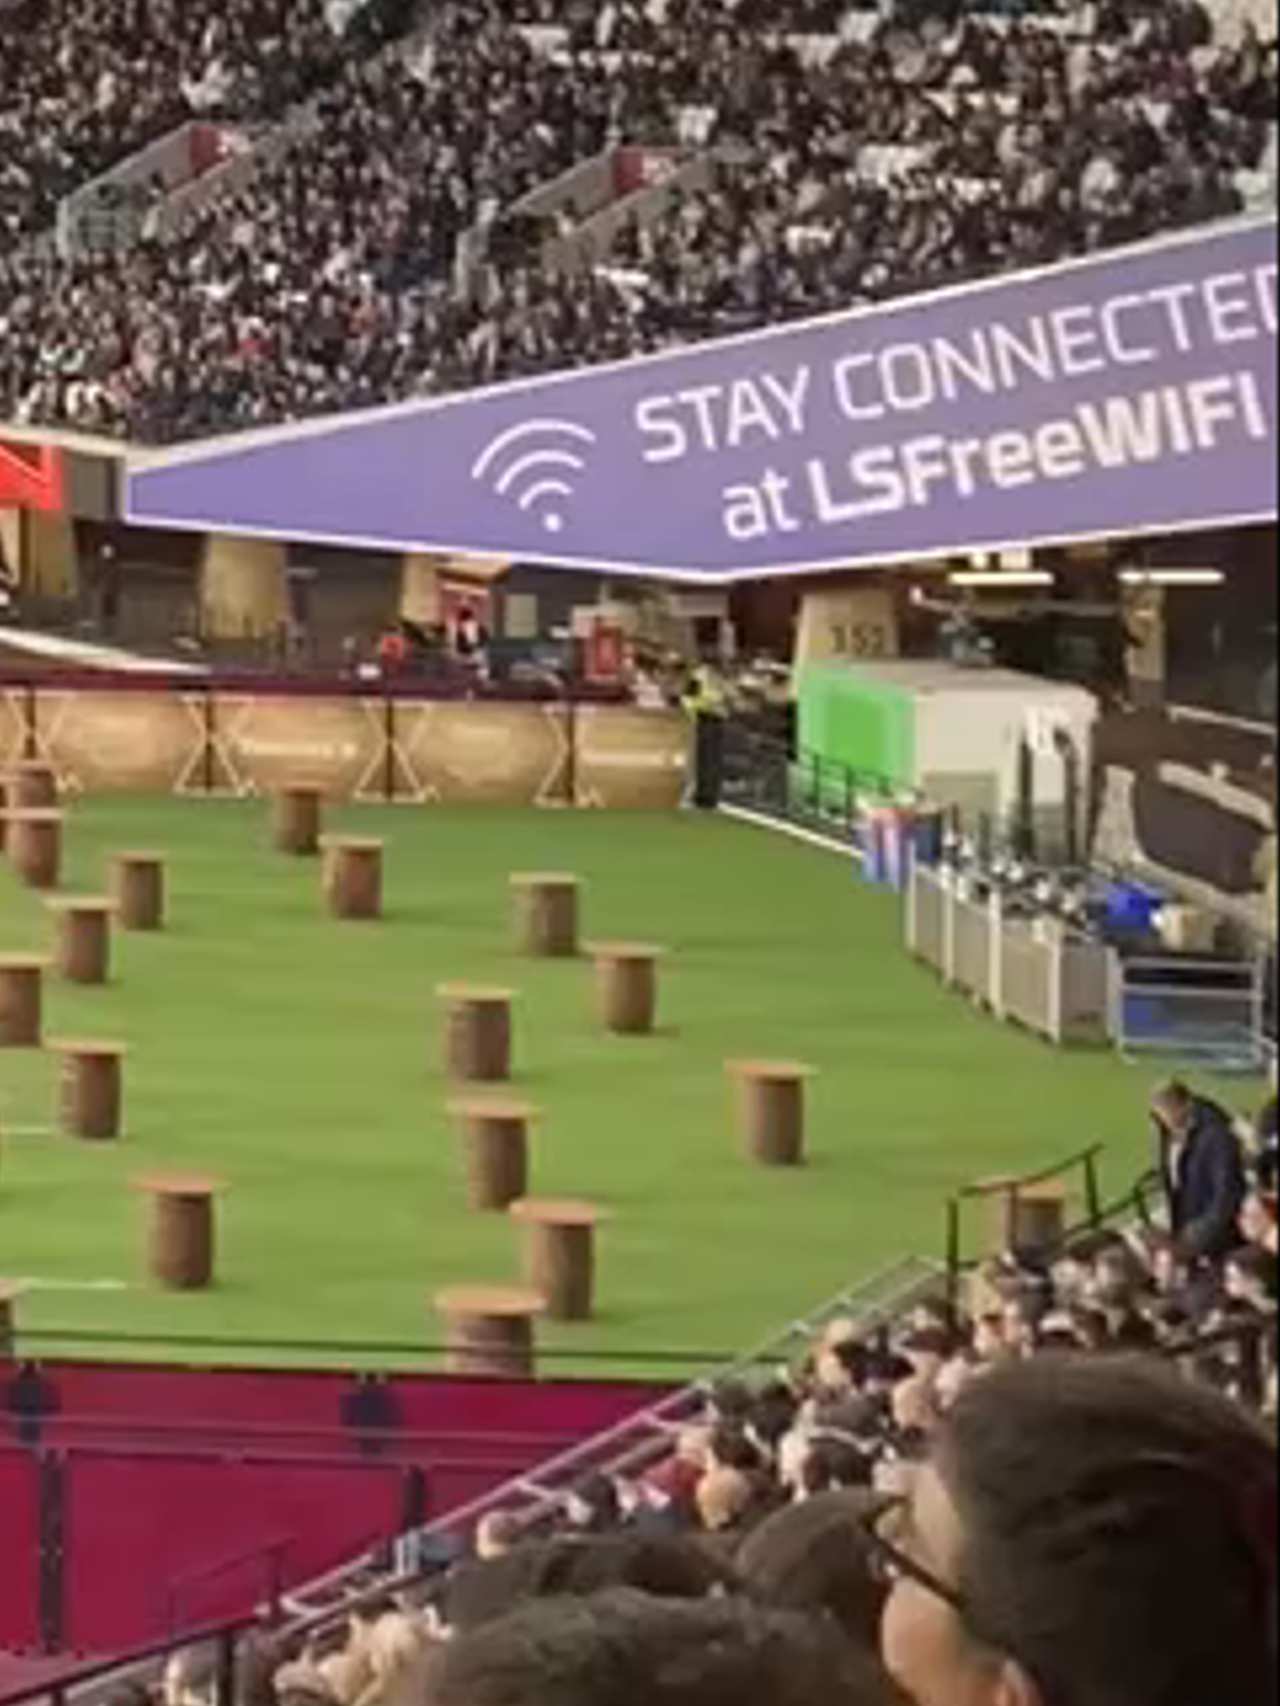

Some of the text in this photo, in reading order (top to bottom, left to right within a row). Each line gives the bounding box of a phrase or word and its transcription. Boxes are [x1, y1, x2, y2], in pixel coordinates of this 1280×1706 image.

[636, 365, 810, 463] STAY
[721, 370, 1268, 541] at LSFreeWIFI
